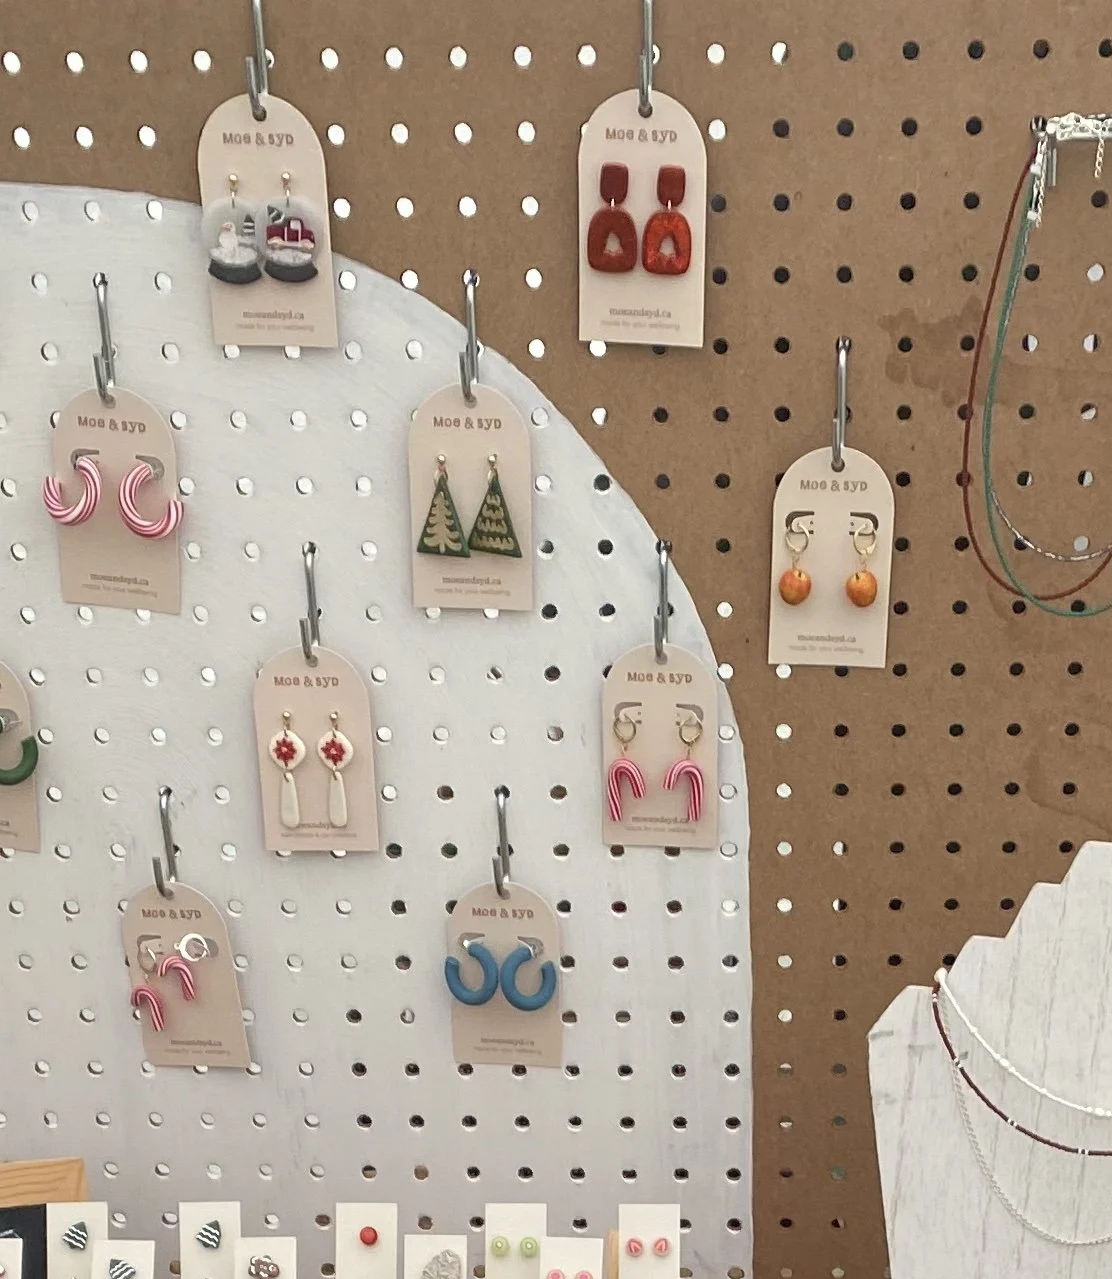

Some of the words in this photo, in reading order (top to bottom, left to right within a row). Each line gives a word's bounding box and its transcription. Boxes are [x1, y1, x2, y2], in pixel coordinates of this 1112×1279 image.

[255, 132, 265, 146] &
[638, 129, 648, 142] &
[109, 418, 119, 431] &
[464, 417, 475, 429] &
[831, 480, 841, 493] &
[303, 676, 313, 687] &
[656, 672, 666, 684] &
[169, 909, 178, 920] &
[500, 908, 509, 919] &
